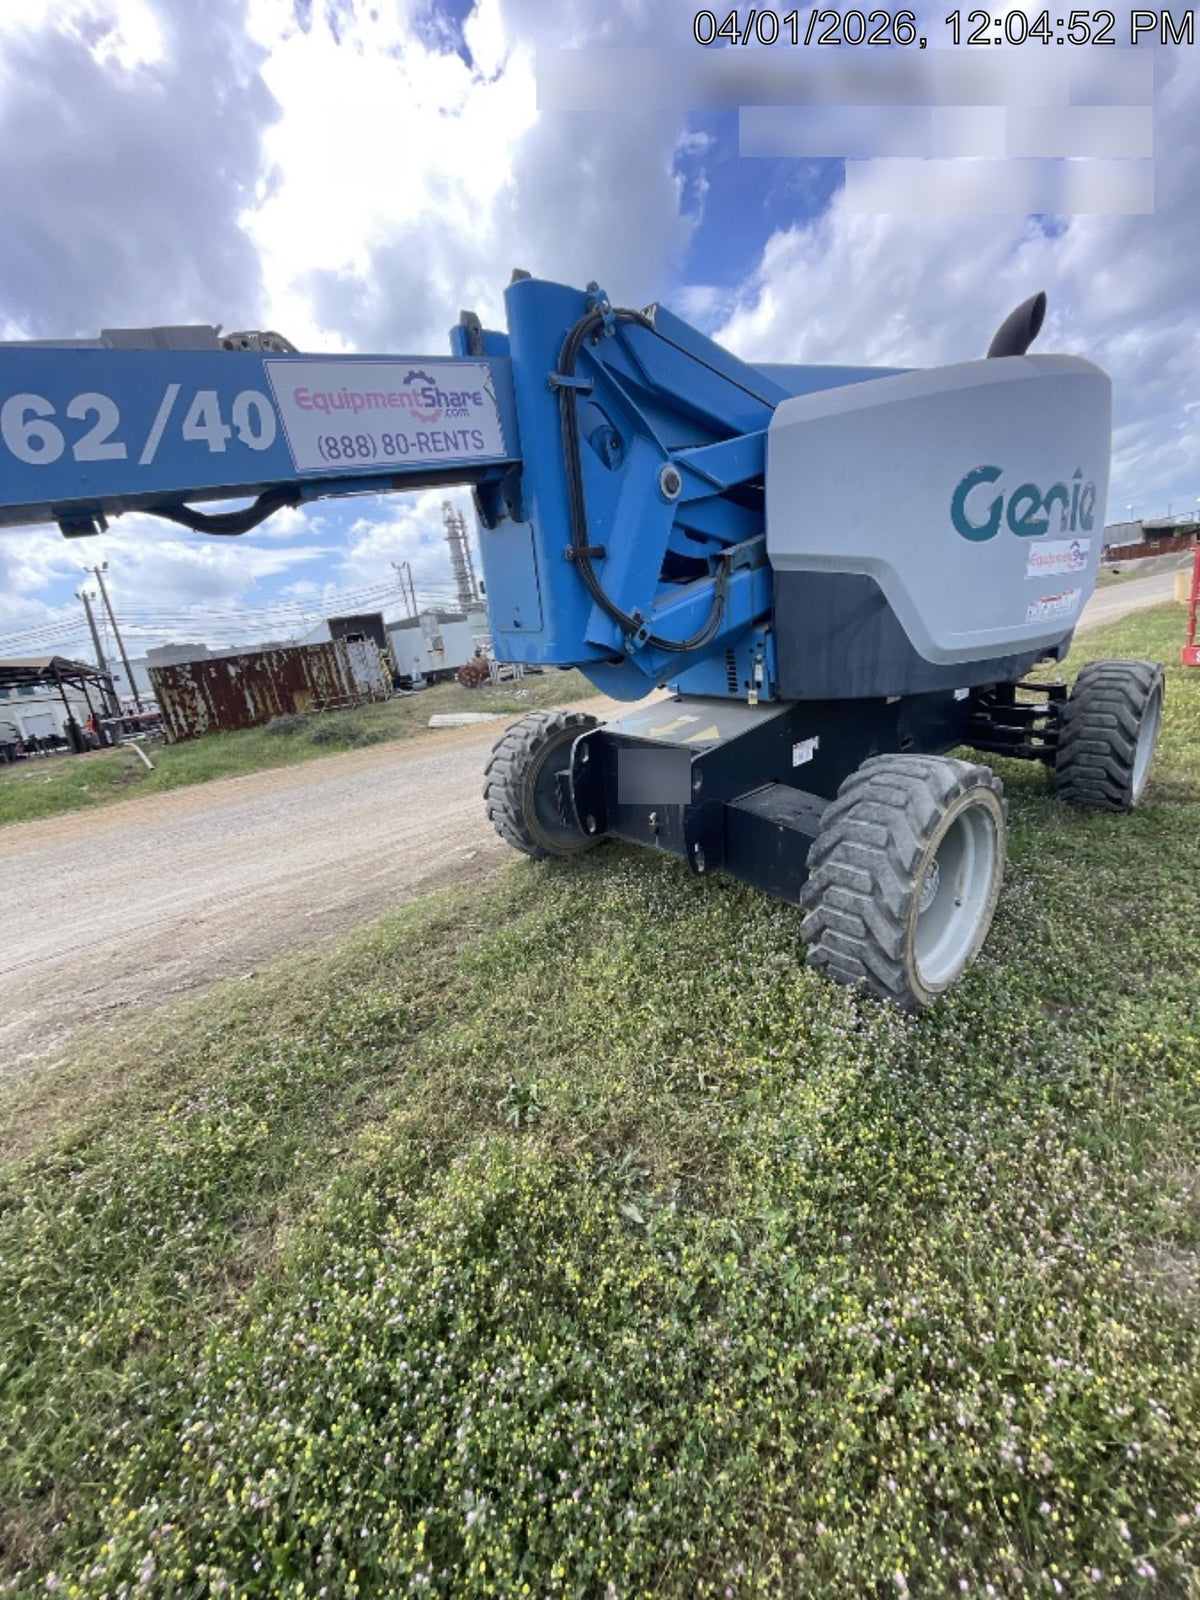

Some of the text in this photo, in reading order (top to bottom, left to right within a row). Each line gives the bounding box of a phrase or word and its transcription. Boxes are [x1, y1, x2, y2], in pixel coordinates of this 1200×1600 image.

[293, 387, 484, 415] EquipmentShare
[318, 429, 484, 461] (888) 80-RENTS
[951, 465, 1097, 542] Genie
